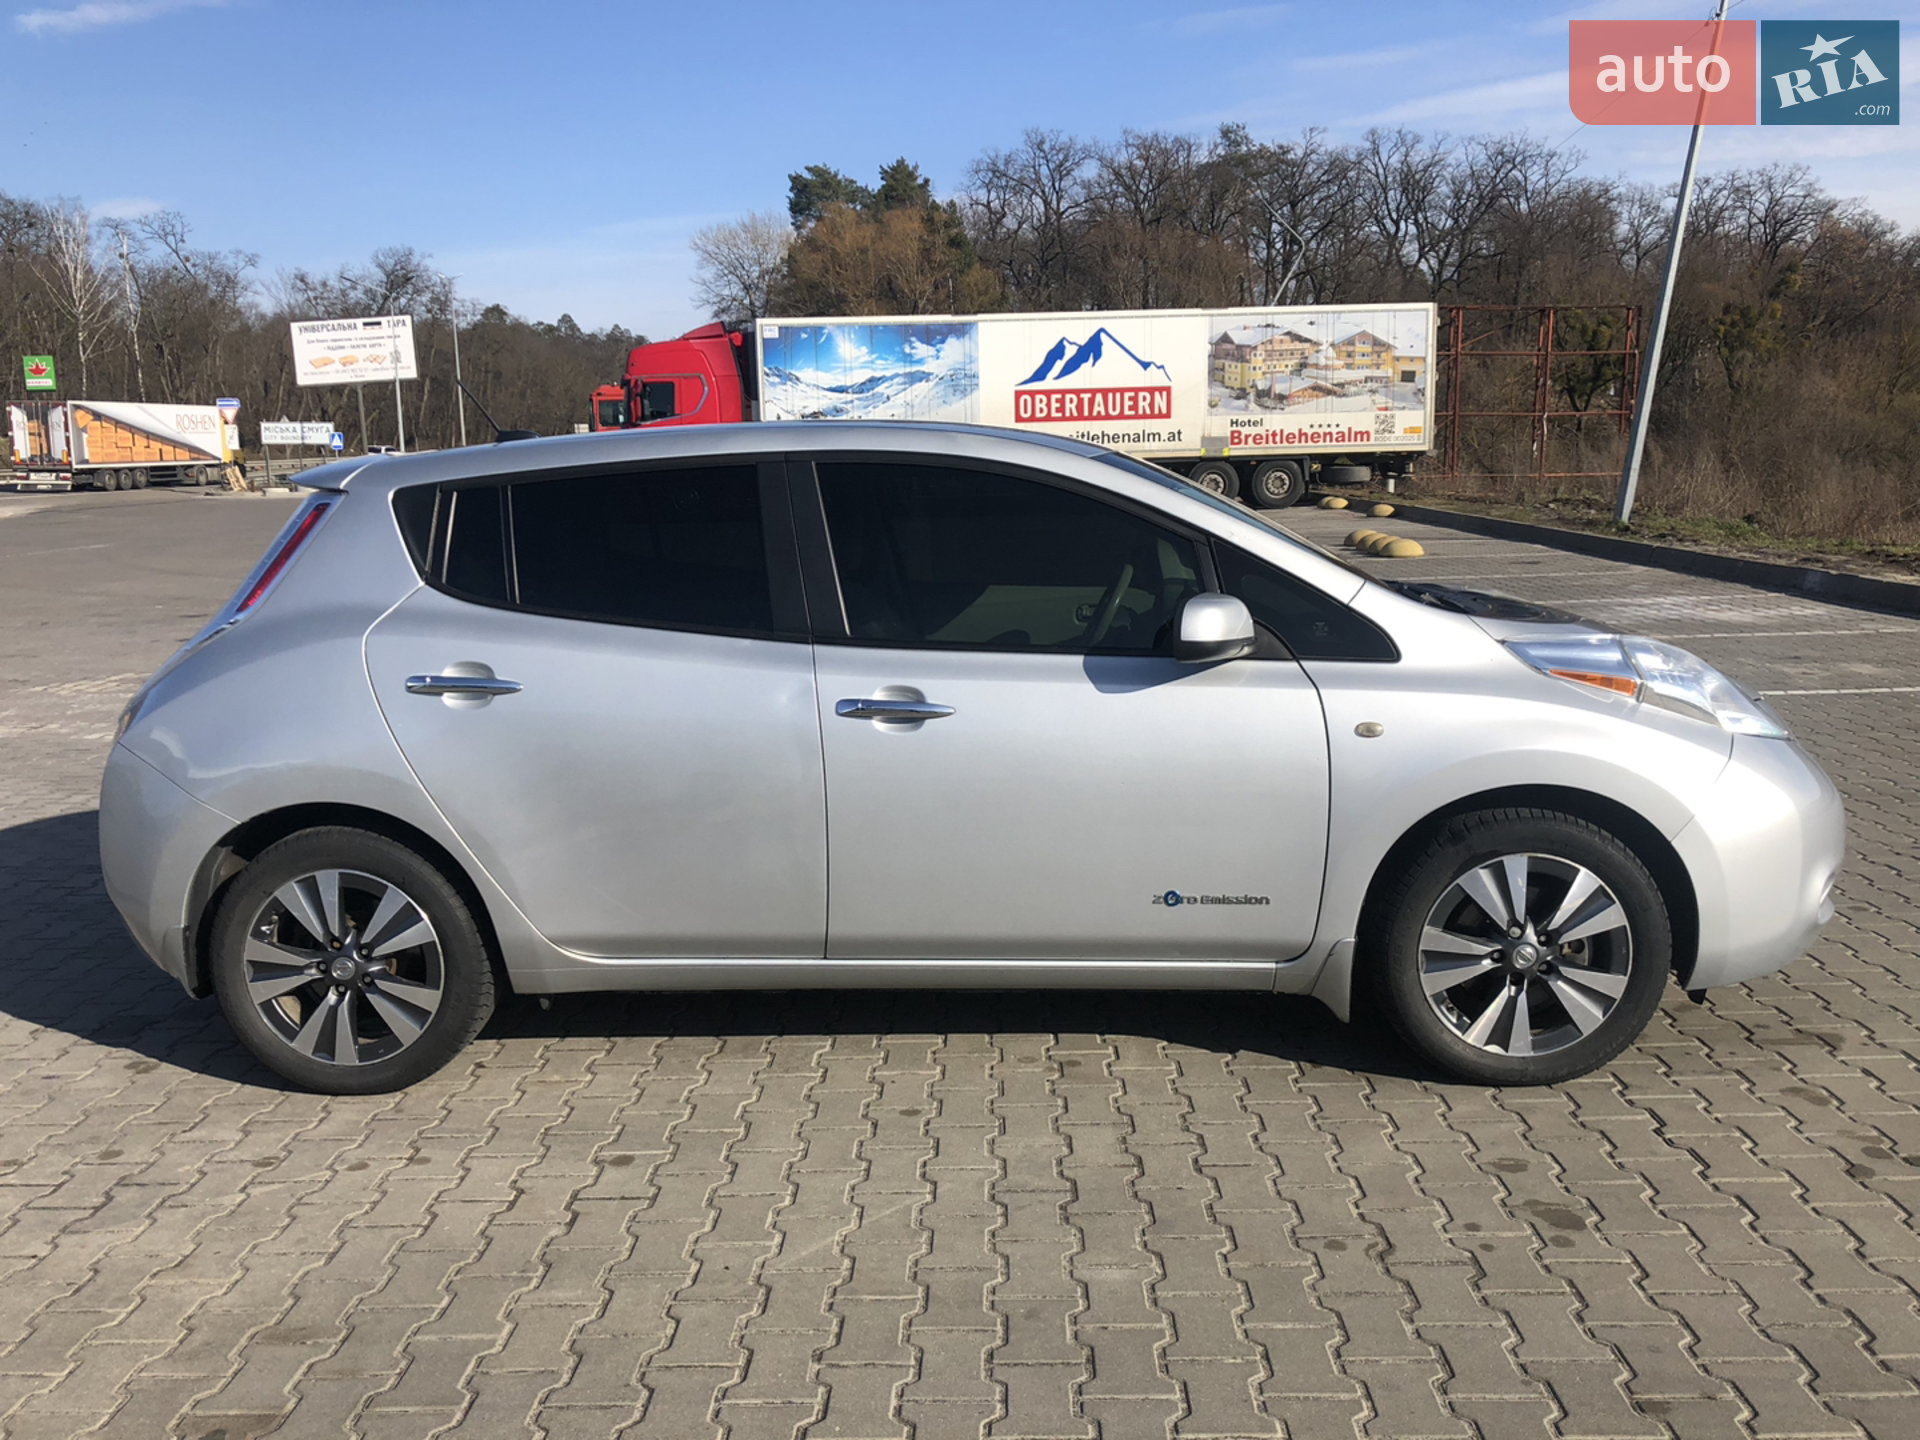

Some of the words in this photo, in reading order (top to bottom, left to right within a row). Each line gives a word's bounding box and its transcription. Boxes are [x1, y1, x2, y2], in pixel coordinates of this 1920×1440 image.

[297, 322, 358, 335] УНІВЕРСАЛЬНА
[386, 318, 407, 329] ТАРА
[1019, 390, 1168, 418] OBERTAUERN
[175, 413, 217, 434] ROSHEN
[263, 425, 298, 434] МІСЬКА
[301, 425, 331, 434] СМУГА
[1230, 417, 1264, 428] Hotel
[1069, 429, 1183, 445] itlehenalm.at
[1229, 426, 1371, 445] Breitlehenalm
[1200, 894, 1270, 906] Emission
